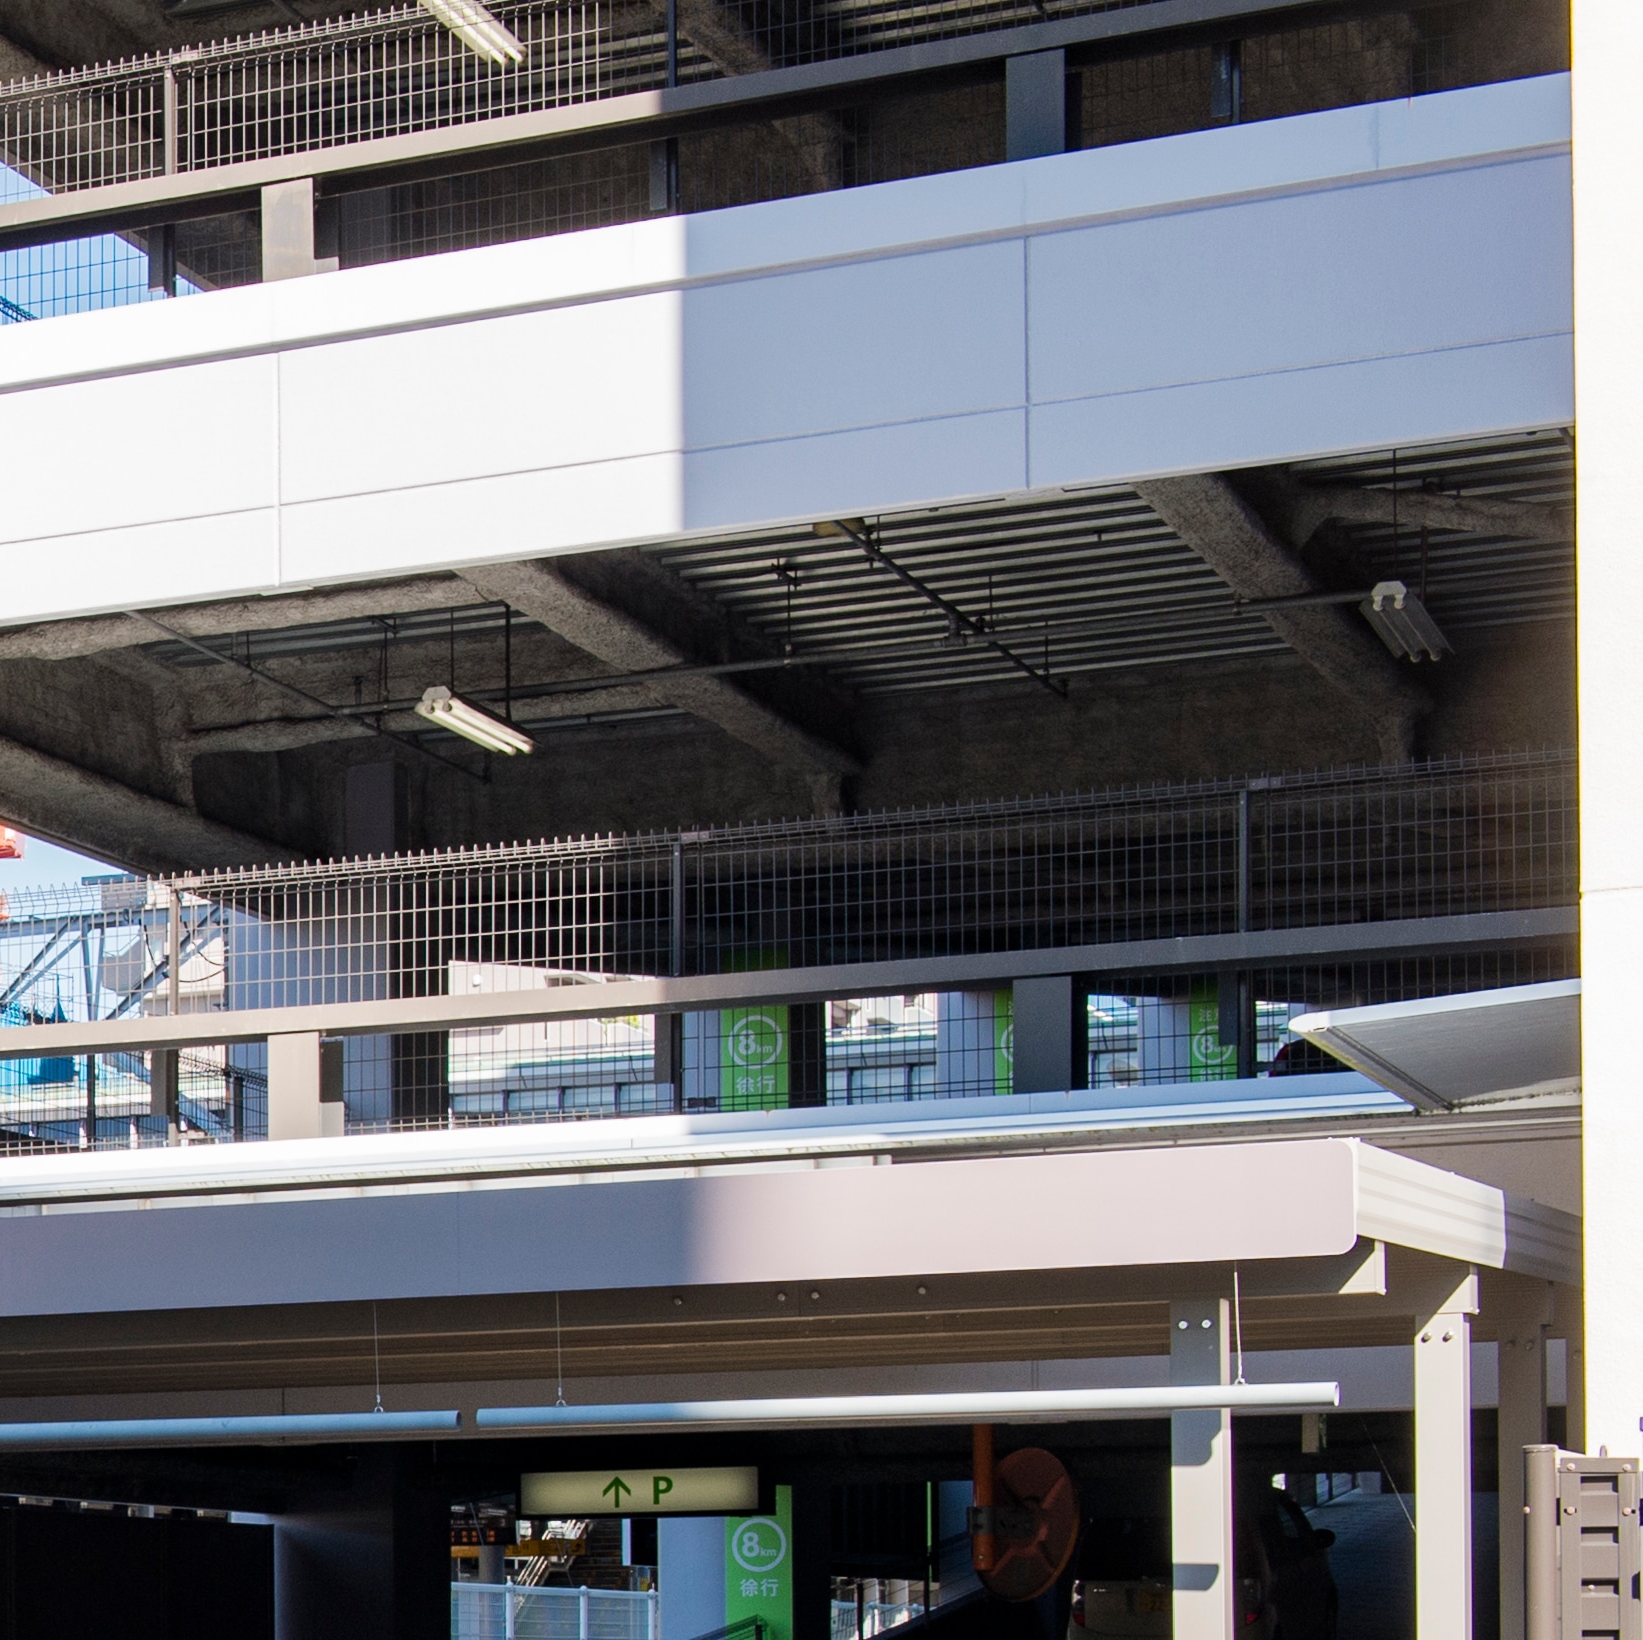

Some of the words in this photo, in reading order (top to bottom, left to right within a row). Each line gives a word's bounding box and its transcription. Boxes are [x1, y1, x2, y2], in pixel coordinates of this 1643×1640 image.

[651, 1476, 674, 1504] P
[742, 1531, 777, 1558] 8km
[739, 1578, 779, 1597] 徐行
